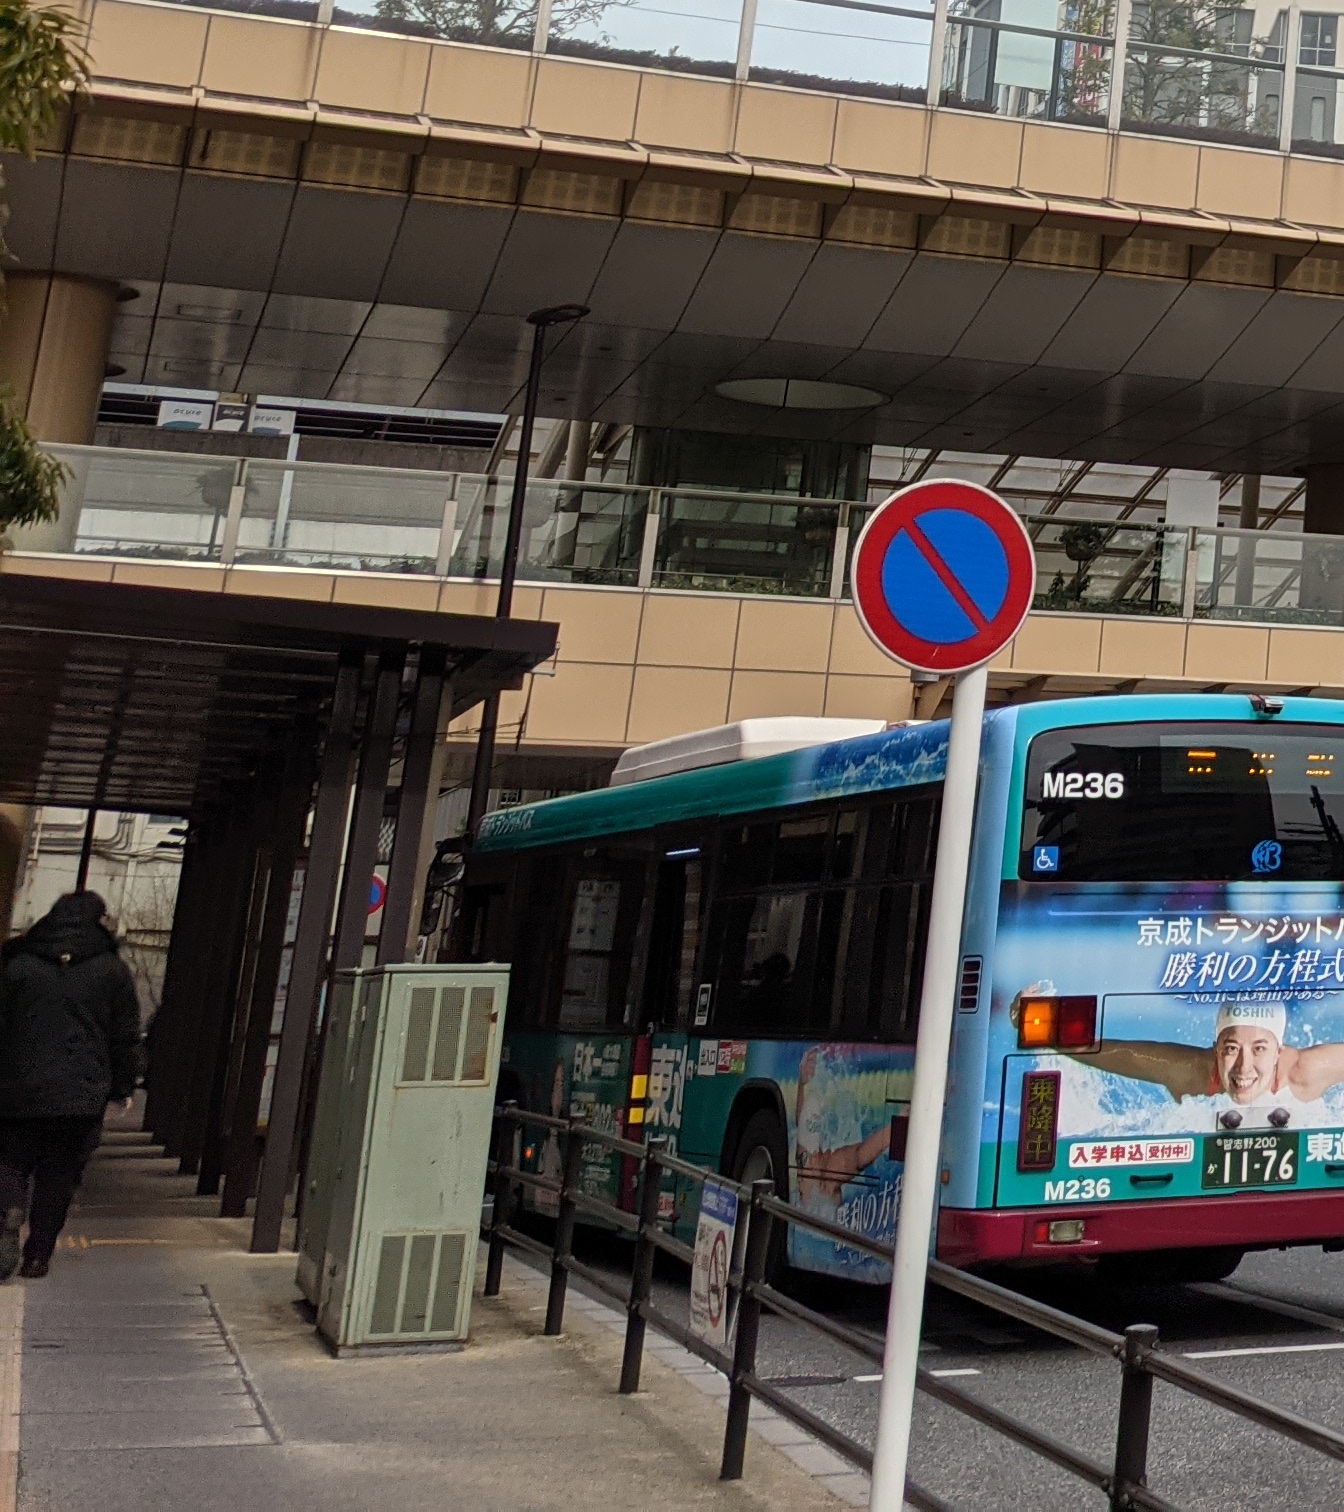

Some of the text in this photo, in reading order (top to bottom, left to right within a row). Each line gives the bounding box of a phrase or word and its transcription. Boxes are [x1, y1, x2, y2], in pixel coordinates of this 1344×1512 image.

[1043, 772, 1124, 799] M236
[1225, 1005, 1275, 1018] TOSHIN
[1254, 1136, 1277, 1148] 200
[1071, 1144, 1145, 1165] 入学申込
[1223, 1148, 1295, 1183] 11-76
[1044, 1178, 1111, 1202] M236
